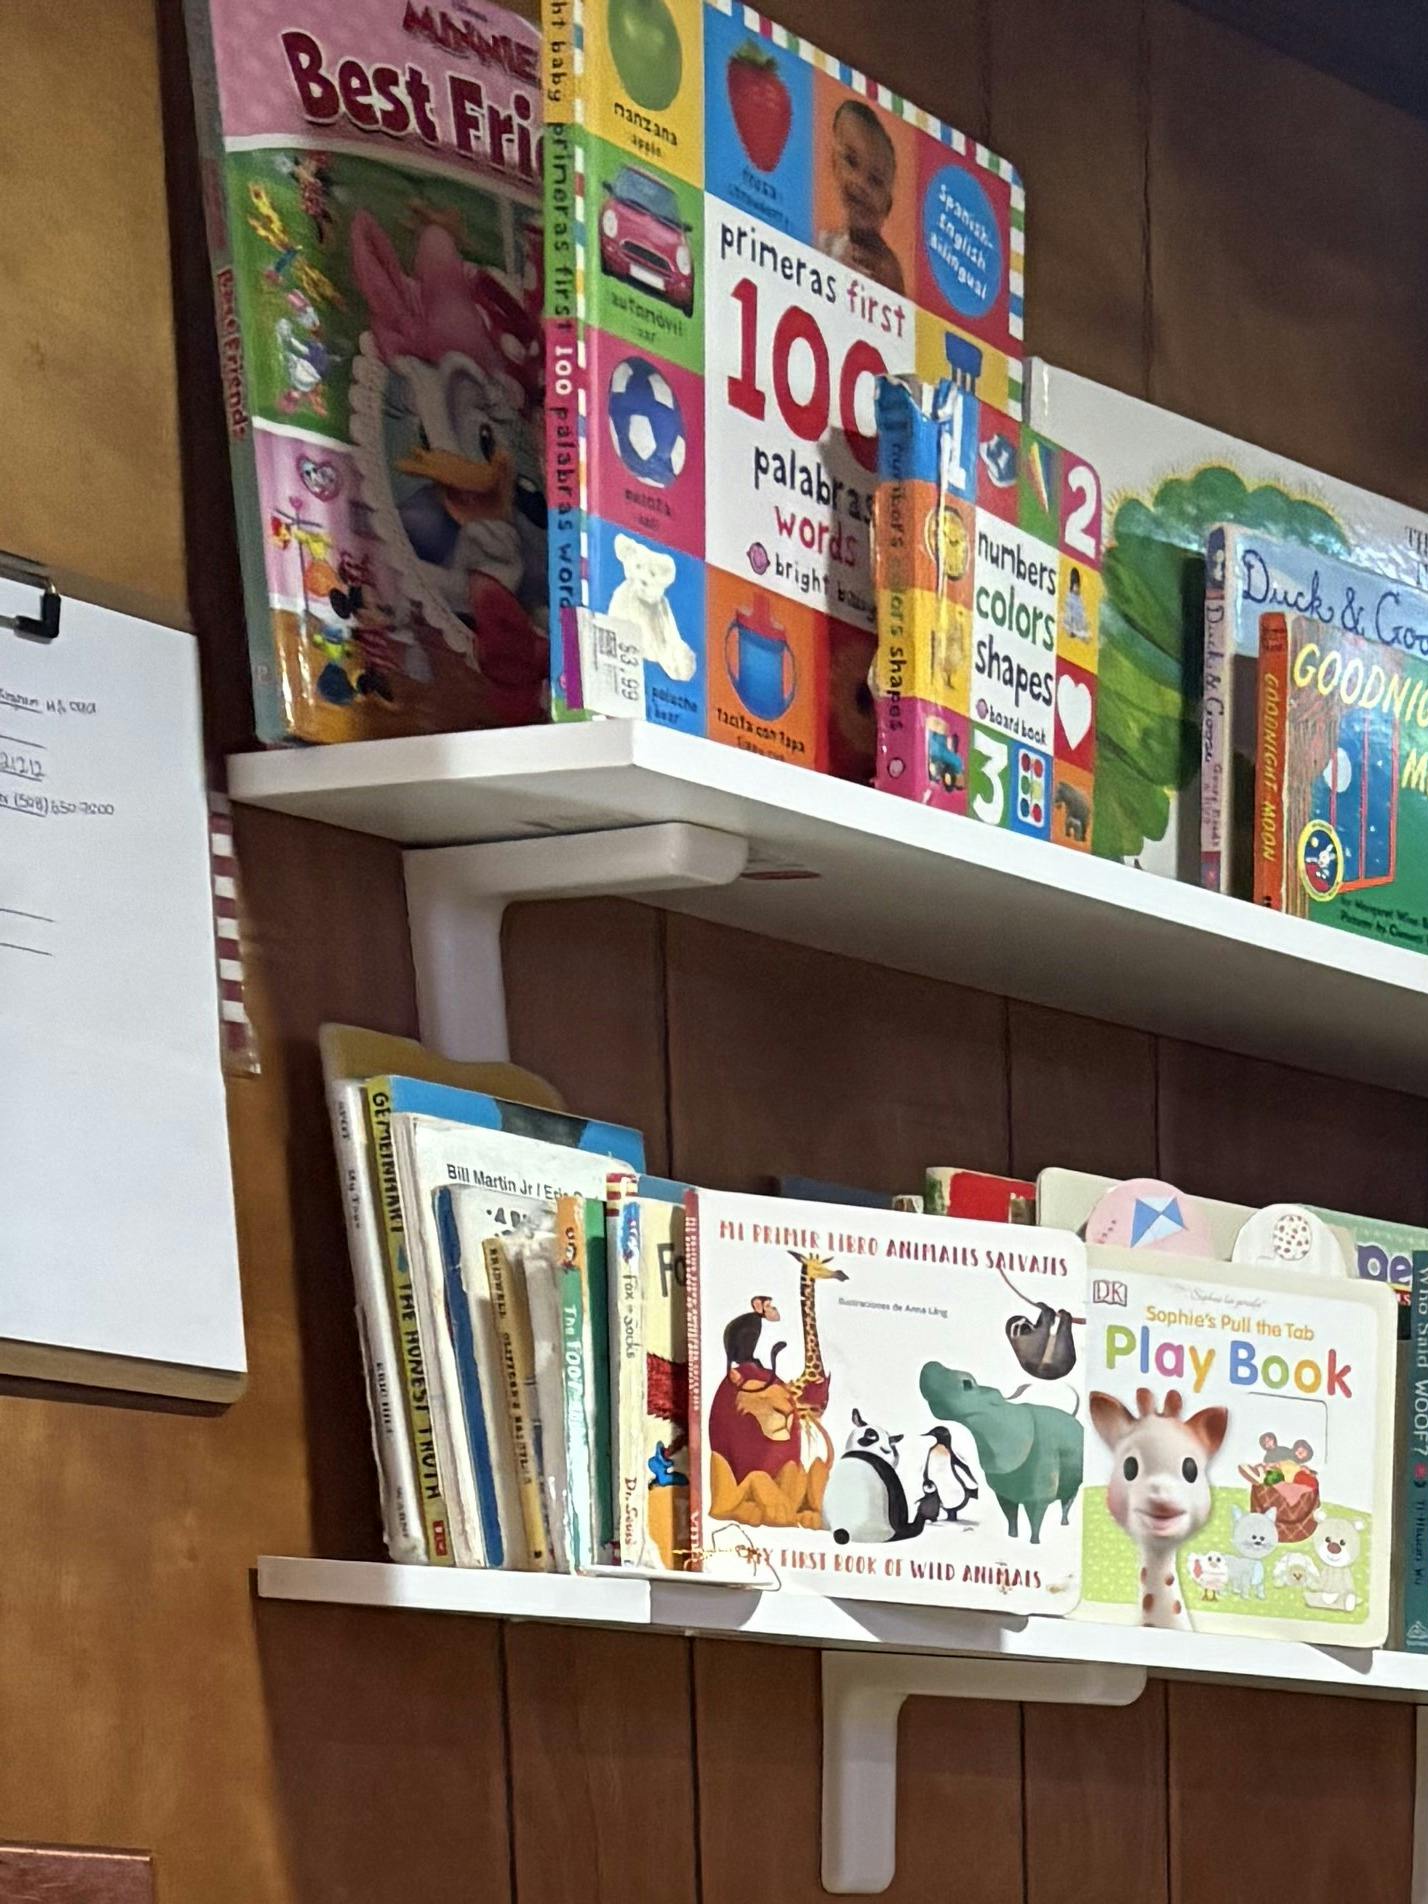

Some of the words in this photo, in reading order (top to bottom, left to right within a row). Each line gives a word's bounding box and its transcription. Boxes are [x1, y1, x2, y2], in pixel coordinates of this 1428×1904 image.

[280, 27, 440, 146] Best
[721, 220, 836, 305] primeras
[846, 278, 906, 339] first
[774, 505, 858, 569] words
[1063, 464, 1098, 560] 2
[977, 530, 1057, 596] numbers
[1241, 550, 1333, 623] Duck
[975, 575, 1056, 655] colors
[974, 637, 1054, 708] shapes
[972, 729, 1009, 826] 3
[447, 1162, 471, 1184] Bill
[473, 1168, 515, 1194] Martin
[517, 1177, 534, 1196] Jr
[1096, 1281, 1123, 1303] DK
[1145, 1305, 1216, 1330] Sophie's
[1220, 1314, 1251, 1334] Pull
[1256, 1318, 1282, 1338] the
[1284, 1323, 1314, 1341] Tab
[1106, 1324, 1216, 1393] Play
[1229, 1340, 1352, 1398] Book
